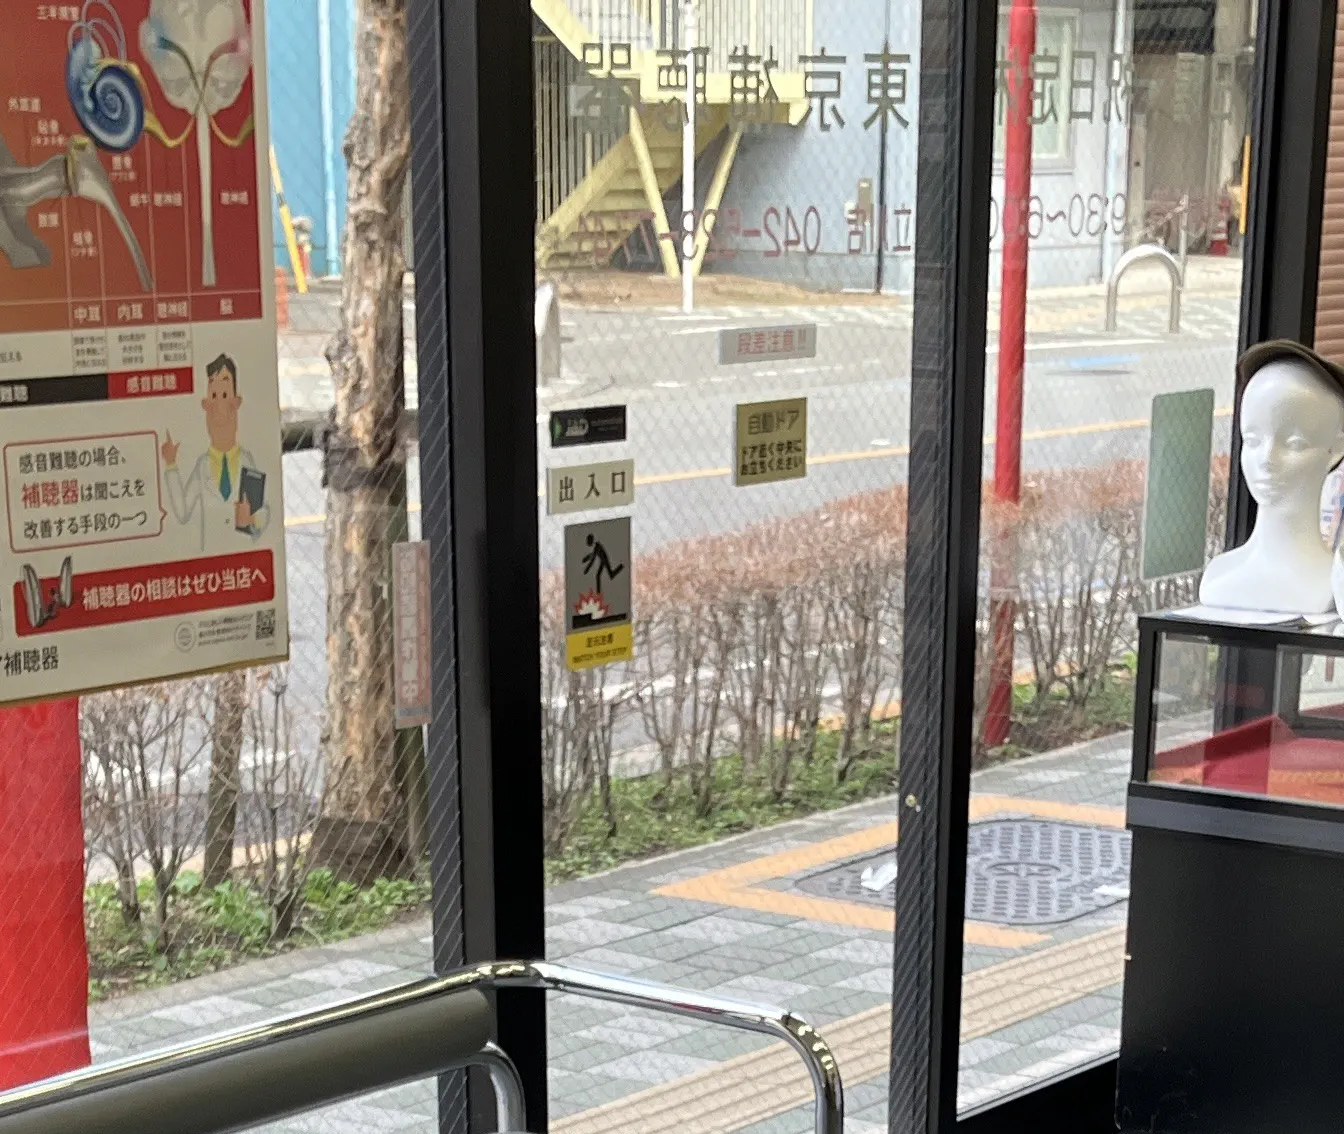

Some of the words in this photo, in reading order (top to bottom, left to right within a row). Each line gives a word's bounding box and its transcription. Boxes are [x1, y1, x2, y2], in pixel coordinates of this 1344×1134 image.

[18, 444, 128, 475] 感音難聴の場合、
[21, 477, 147, 510] 補聴器は聞こえを
[558, 469, 627, 504] 出入口
[23, 509, 149, 542] 改善する手段の一つ
[80, 565, 269, 614] 補聴器の相談はぜひ当店へ
